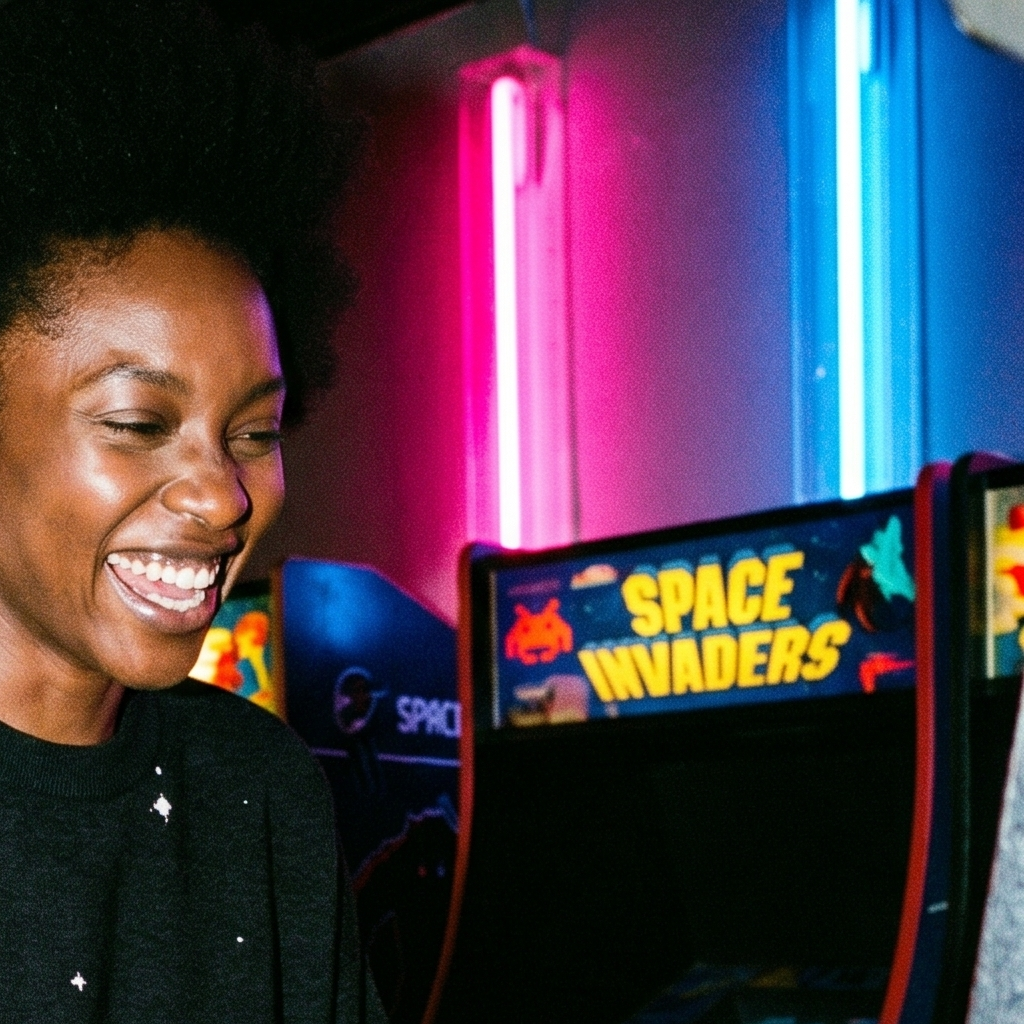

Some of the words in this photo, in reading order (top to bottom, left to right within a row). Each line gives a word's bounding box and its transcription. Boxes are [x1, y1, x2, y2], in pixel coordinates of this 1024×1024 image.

[620, 549, 805, 638] SPACE
[577, 618, 853, 703] INVADERS
[396, 694, 463, 739] SPAC
